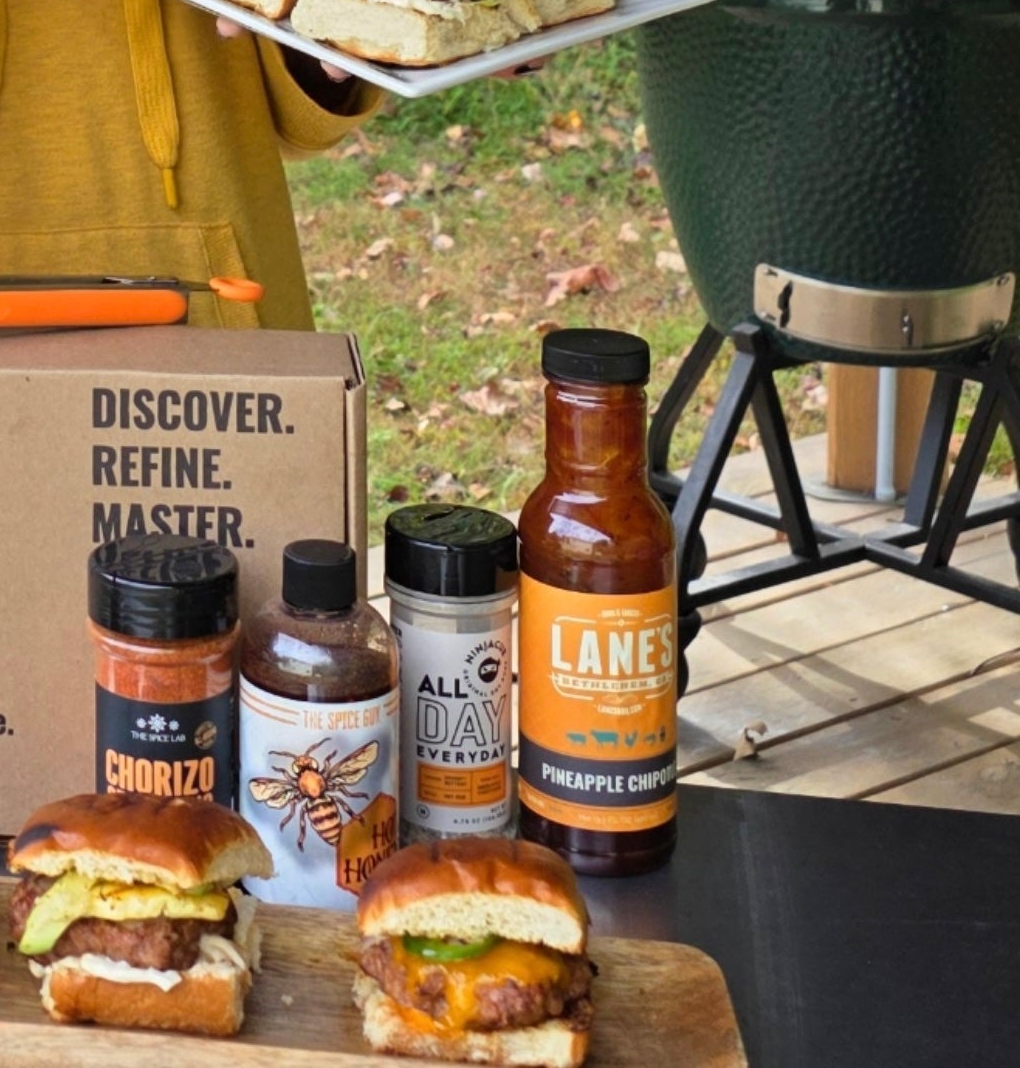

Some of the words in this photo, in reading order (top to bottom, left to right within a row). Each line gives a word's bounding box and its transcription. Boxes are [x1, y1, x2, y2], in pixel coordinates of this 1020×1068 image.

[92, 388, 295, 434] DISCOVER.
[92, 445, 233, 489] REFINE.
[92, 502, 254, 548] MASTER.
[551, 622, 673, 676] LANE'S
[418, 674, 469, 699] ALL
[131, 730, 148, 741] THE
[149, 732, 169, 743] SPICE
[170, 733, 186, 743] LAB
[303, 710, 324, 729] THE
[327, 710, 359, 731] SPICE
[416, 695, 507, 747] DAY
[105, 749, 215, 796] CHORIZO
[417, 744, 506, 764] EVERYDAY
[542, 763, 625, 793] PINEAPPLE
[372, 815, 397, 849] HO
